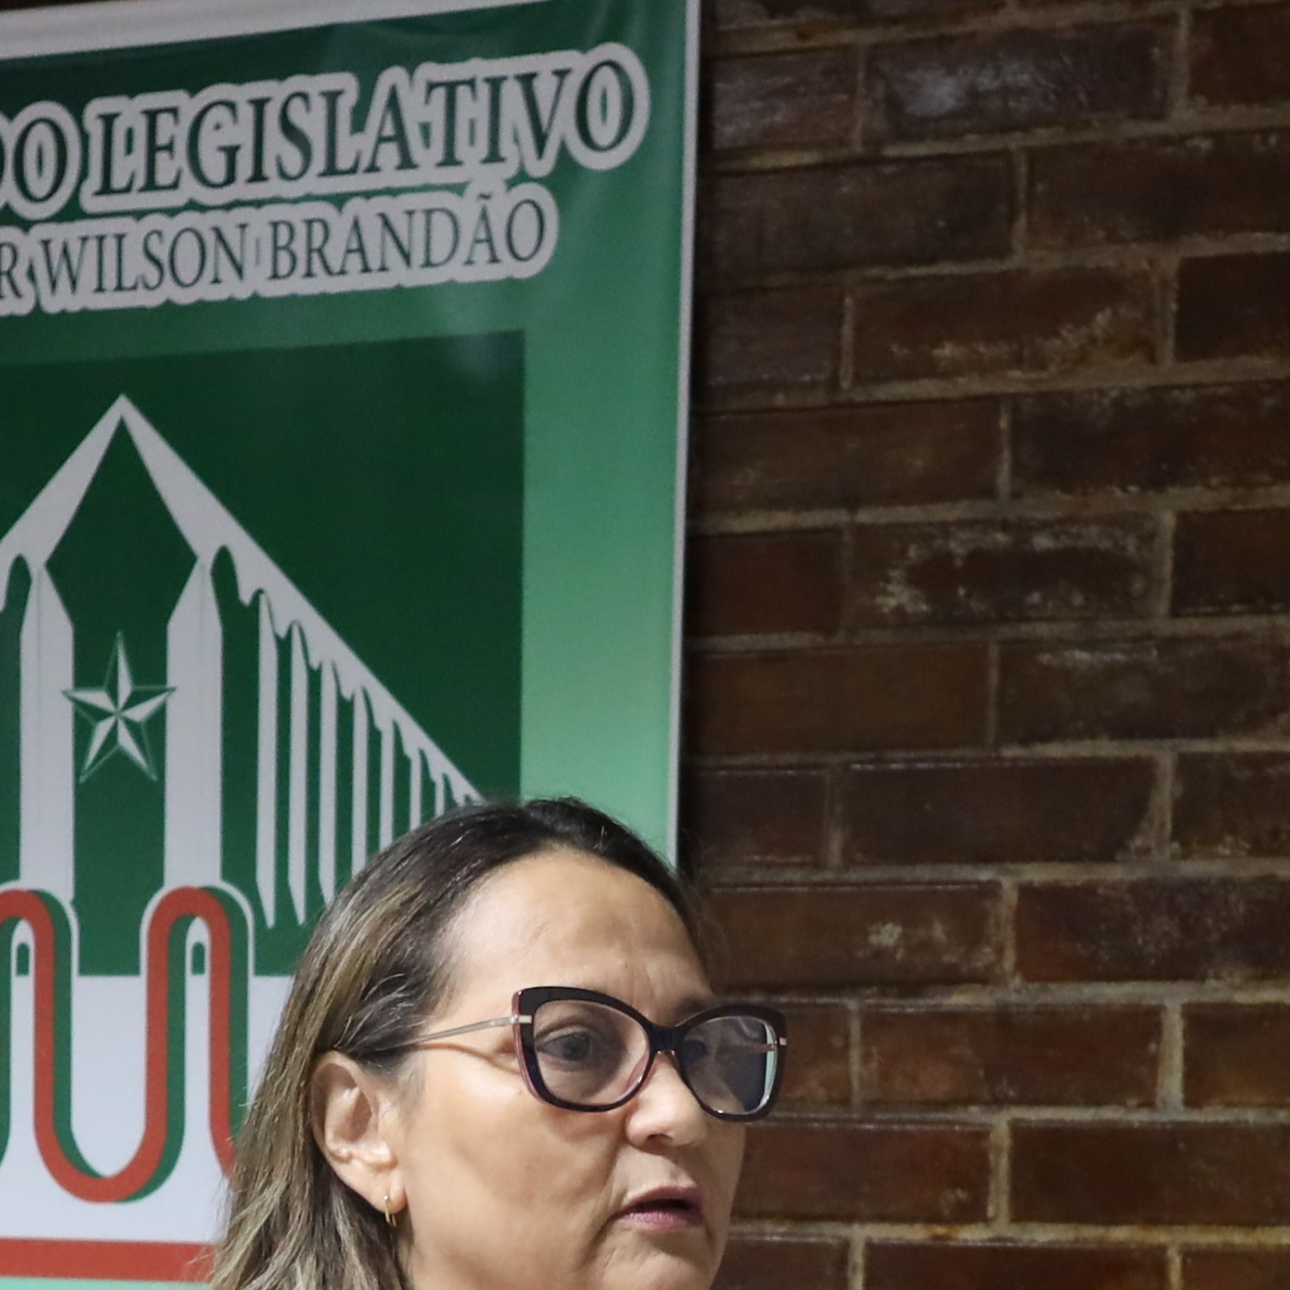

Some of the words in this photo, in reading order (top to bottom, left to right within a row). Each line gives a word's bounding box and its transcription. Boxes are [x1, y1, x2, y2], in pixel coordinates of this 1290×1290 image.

[92, 59, 635, 197] LEGISLATIVO
[39, 222, 250, 296] WILSON
[266, 193, 546, 281] BRANDÃO
